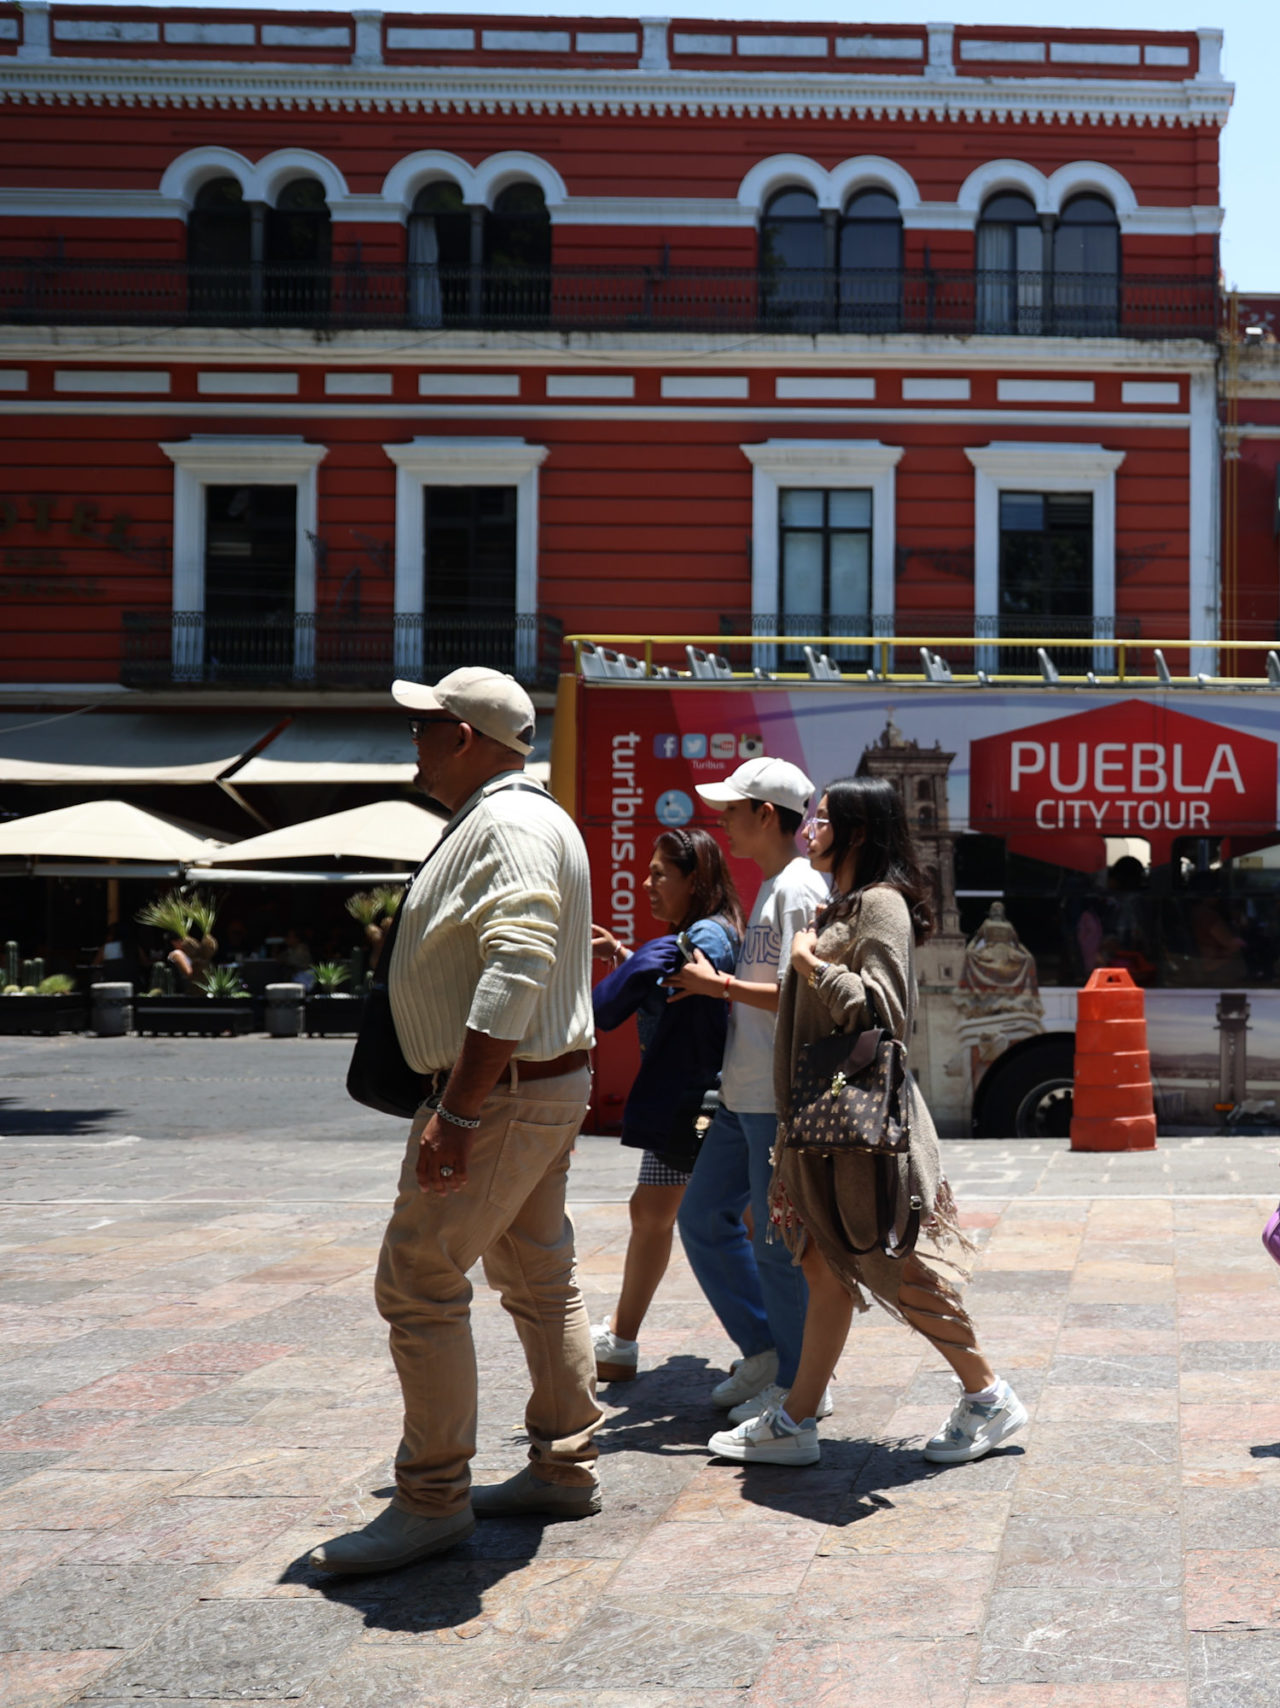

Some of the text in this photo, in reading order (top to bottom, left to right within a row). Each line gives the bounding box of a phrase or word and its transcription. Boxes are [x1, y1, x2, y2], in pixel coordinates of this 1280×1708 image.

[1010, 741, 1246, 793] PUEBLA
[611, 731, 643, 945] turibus.com
[1035, 799, 1210, 829] CITY TOUR
